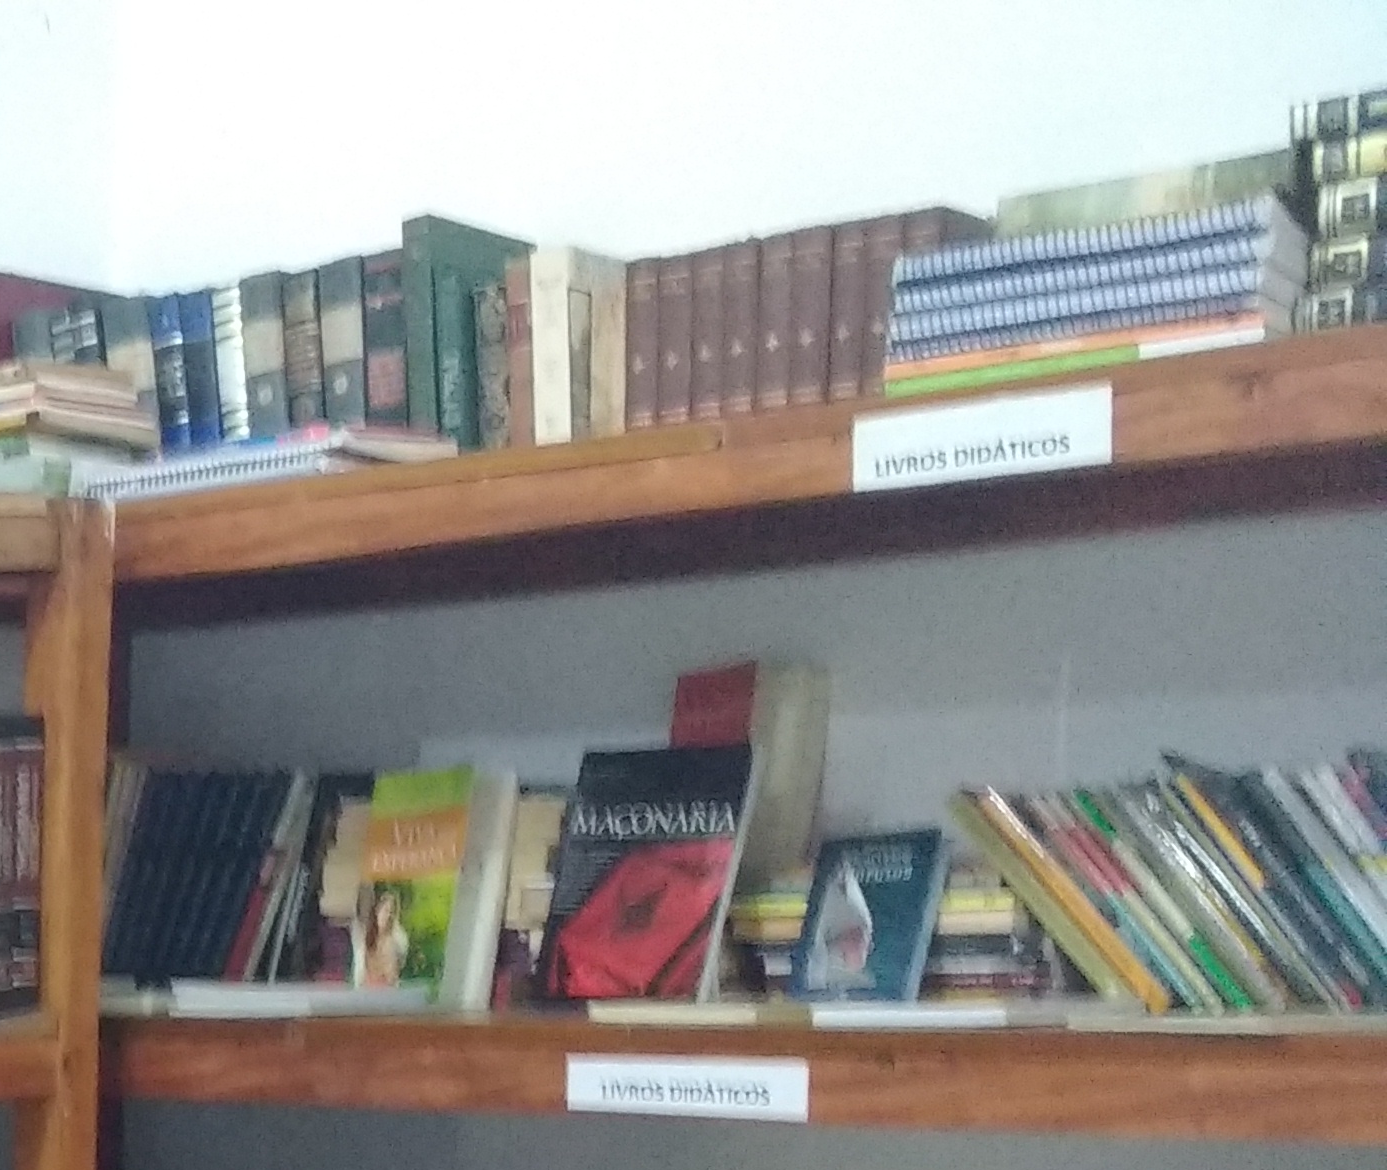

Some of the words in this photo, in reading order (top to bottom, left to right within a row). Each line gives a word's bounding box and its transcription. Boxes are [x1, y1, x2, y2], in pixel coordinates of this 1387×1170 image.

[875, 451, 947, 478] LIVROS
[954, 435, 1070, 469] DIDÁTICOS
[570, 800, 735, 839] MAÇONARIA
[600, 1081, 664, 1103] LIVROS
[670, 1079, 772, 1107] DIDÁTICOS
